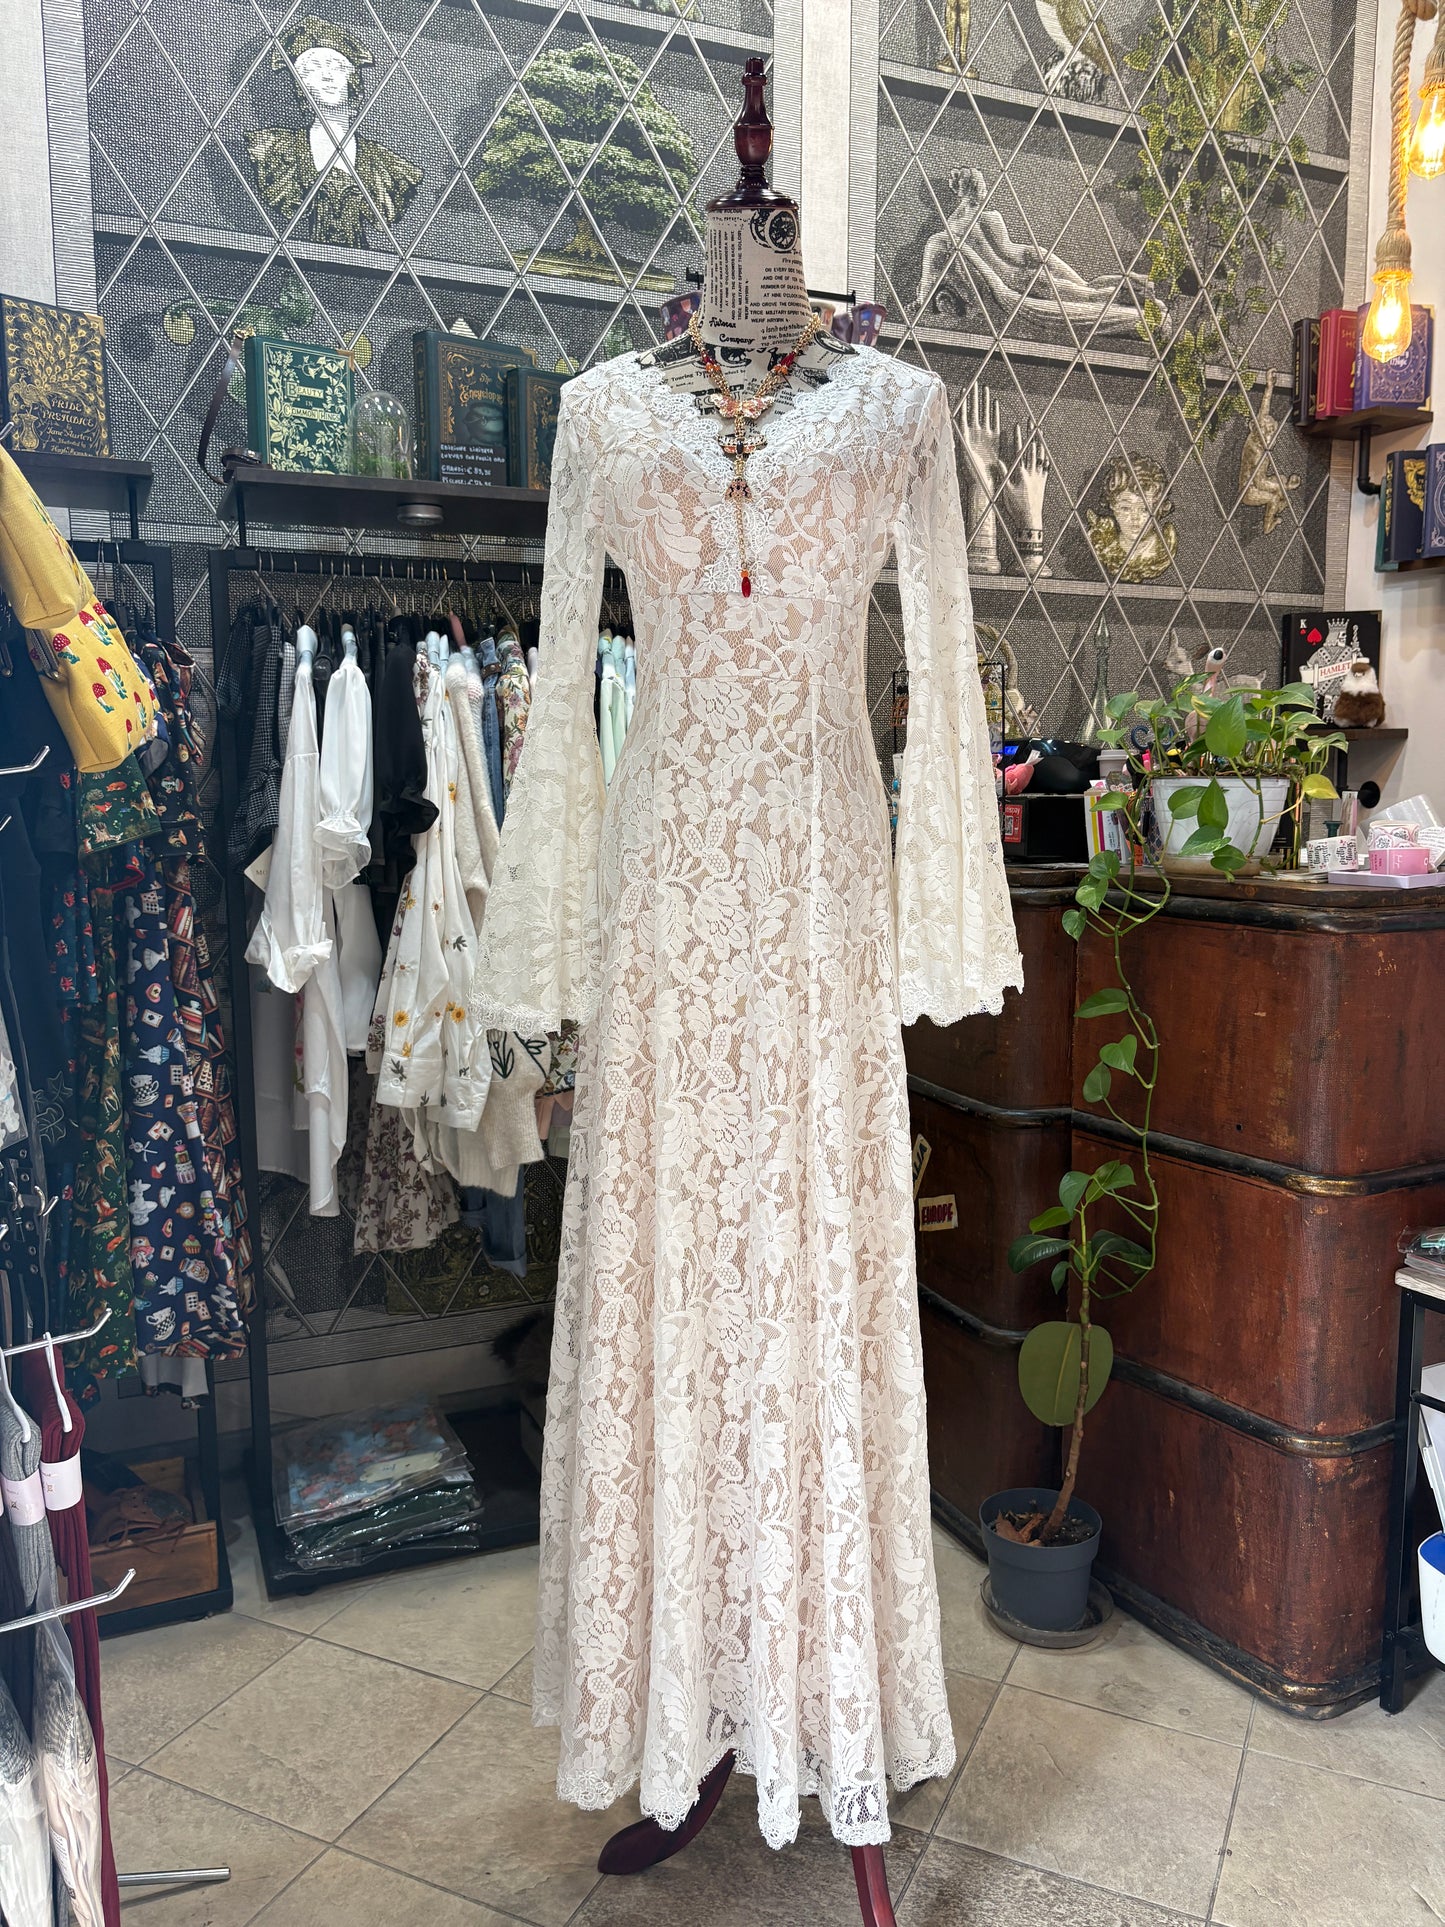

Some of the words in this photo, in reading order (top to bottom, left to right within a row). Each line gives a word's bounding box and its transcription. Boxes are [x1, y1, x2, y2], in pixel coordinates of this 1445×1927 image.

[719, 333, 756, 345] Company
[287, 383, 323, 397] BEAUTY
[51, 398, 82, 412] PRIDE
[42, 409, 94, 427] PREJUDICE
[1300, 619, 1307, 629] K
[1320, 662, 1351, 677] HAMLET
[921, 1202, 954, 1225] EUROPE
